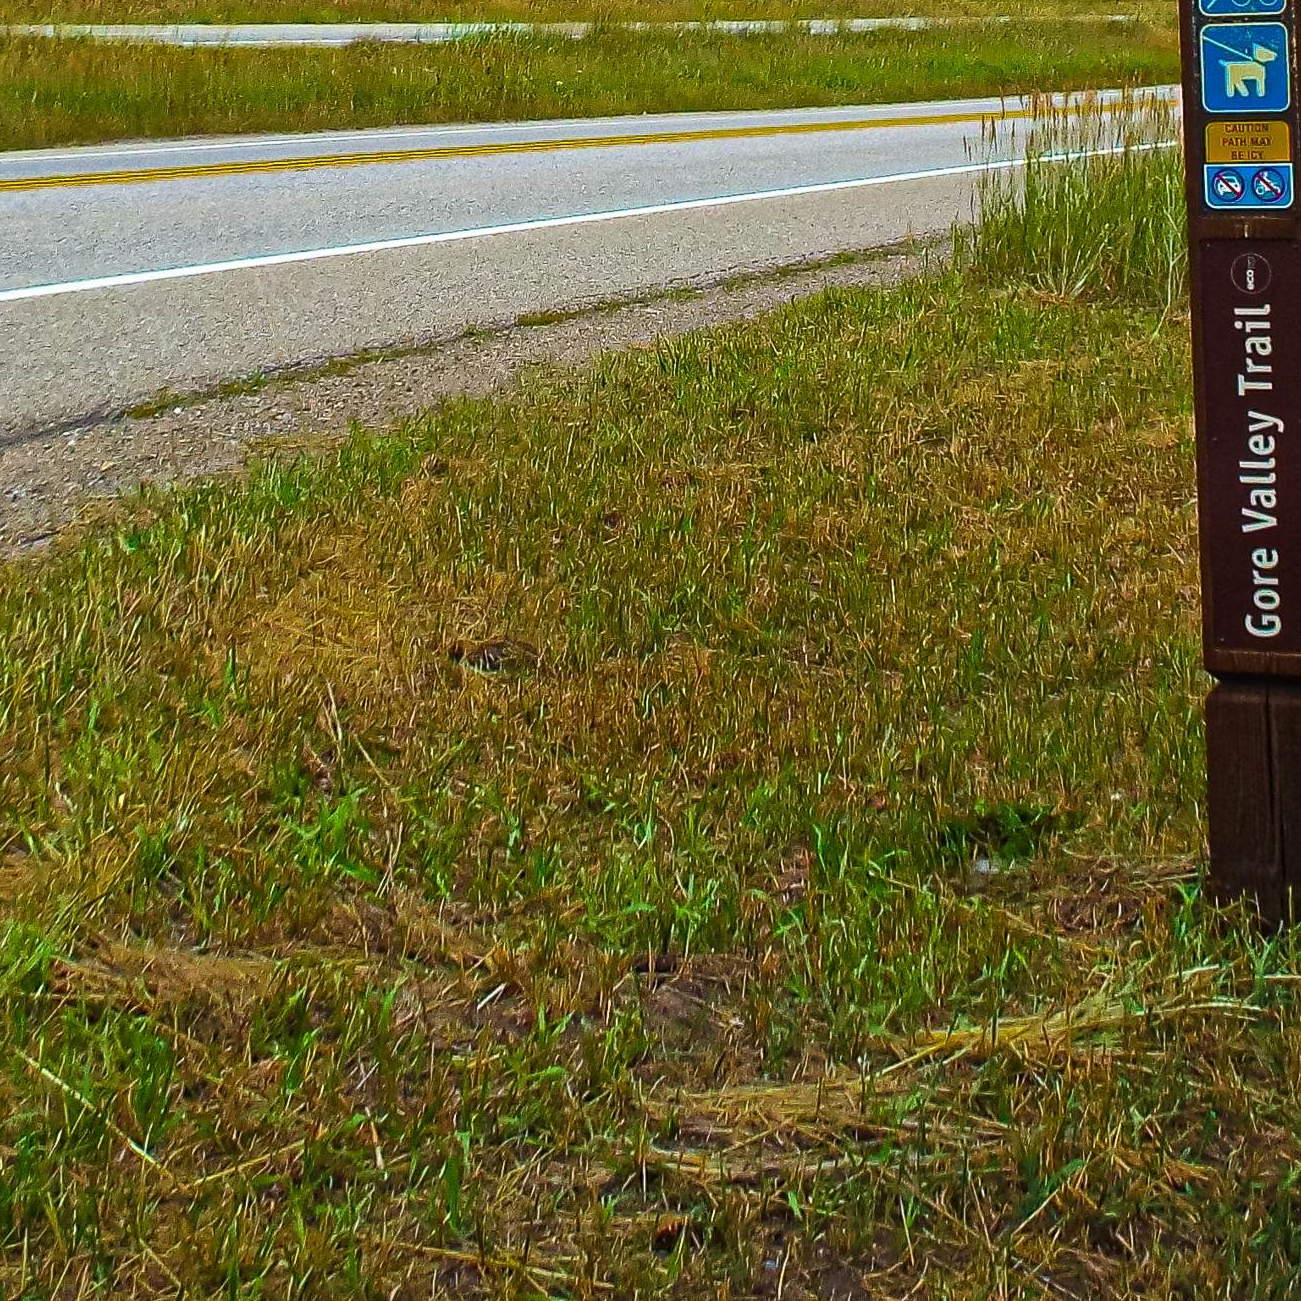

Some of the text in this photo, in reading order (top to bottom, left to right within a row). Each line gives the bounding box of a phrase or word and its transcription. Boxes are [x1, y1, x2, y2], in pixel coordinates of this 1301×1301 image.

[1224, 123, 1270, 133] CAUTION
[1222, 137, 1272, 147] PATH MAY
[1231, 151, 1264, 160] BE ICY
[1233, 303, 1285, 637] Gore Valley Trail
